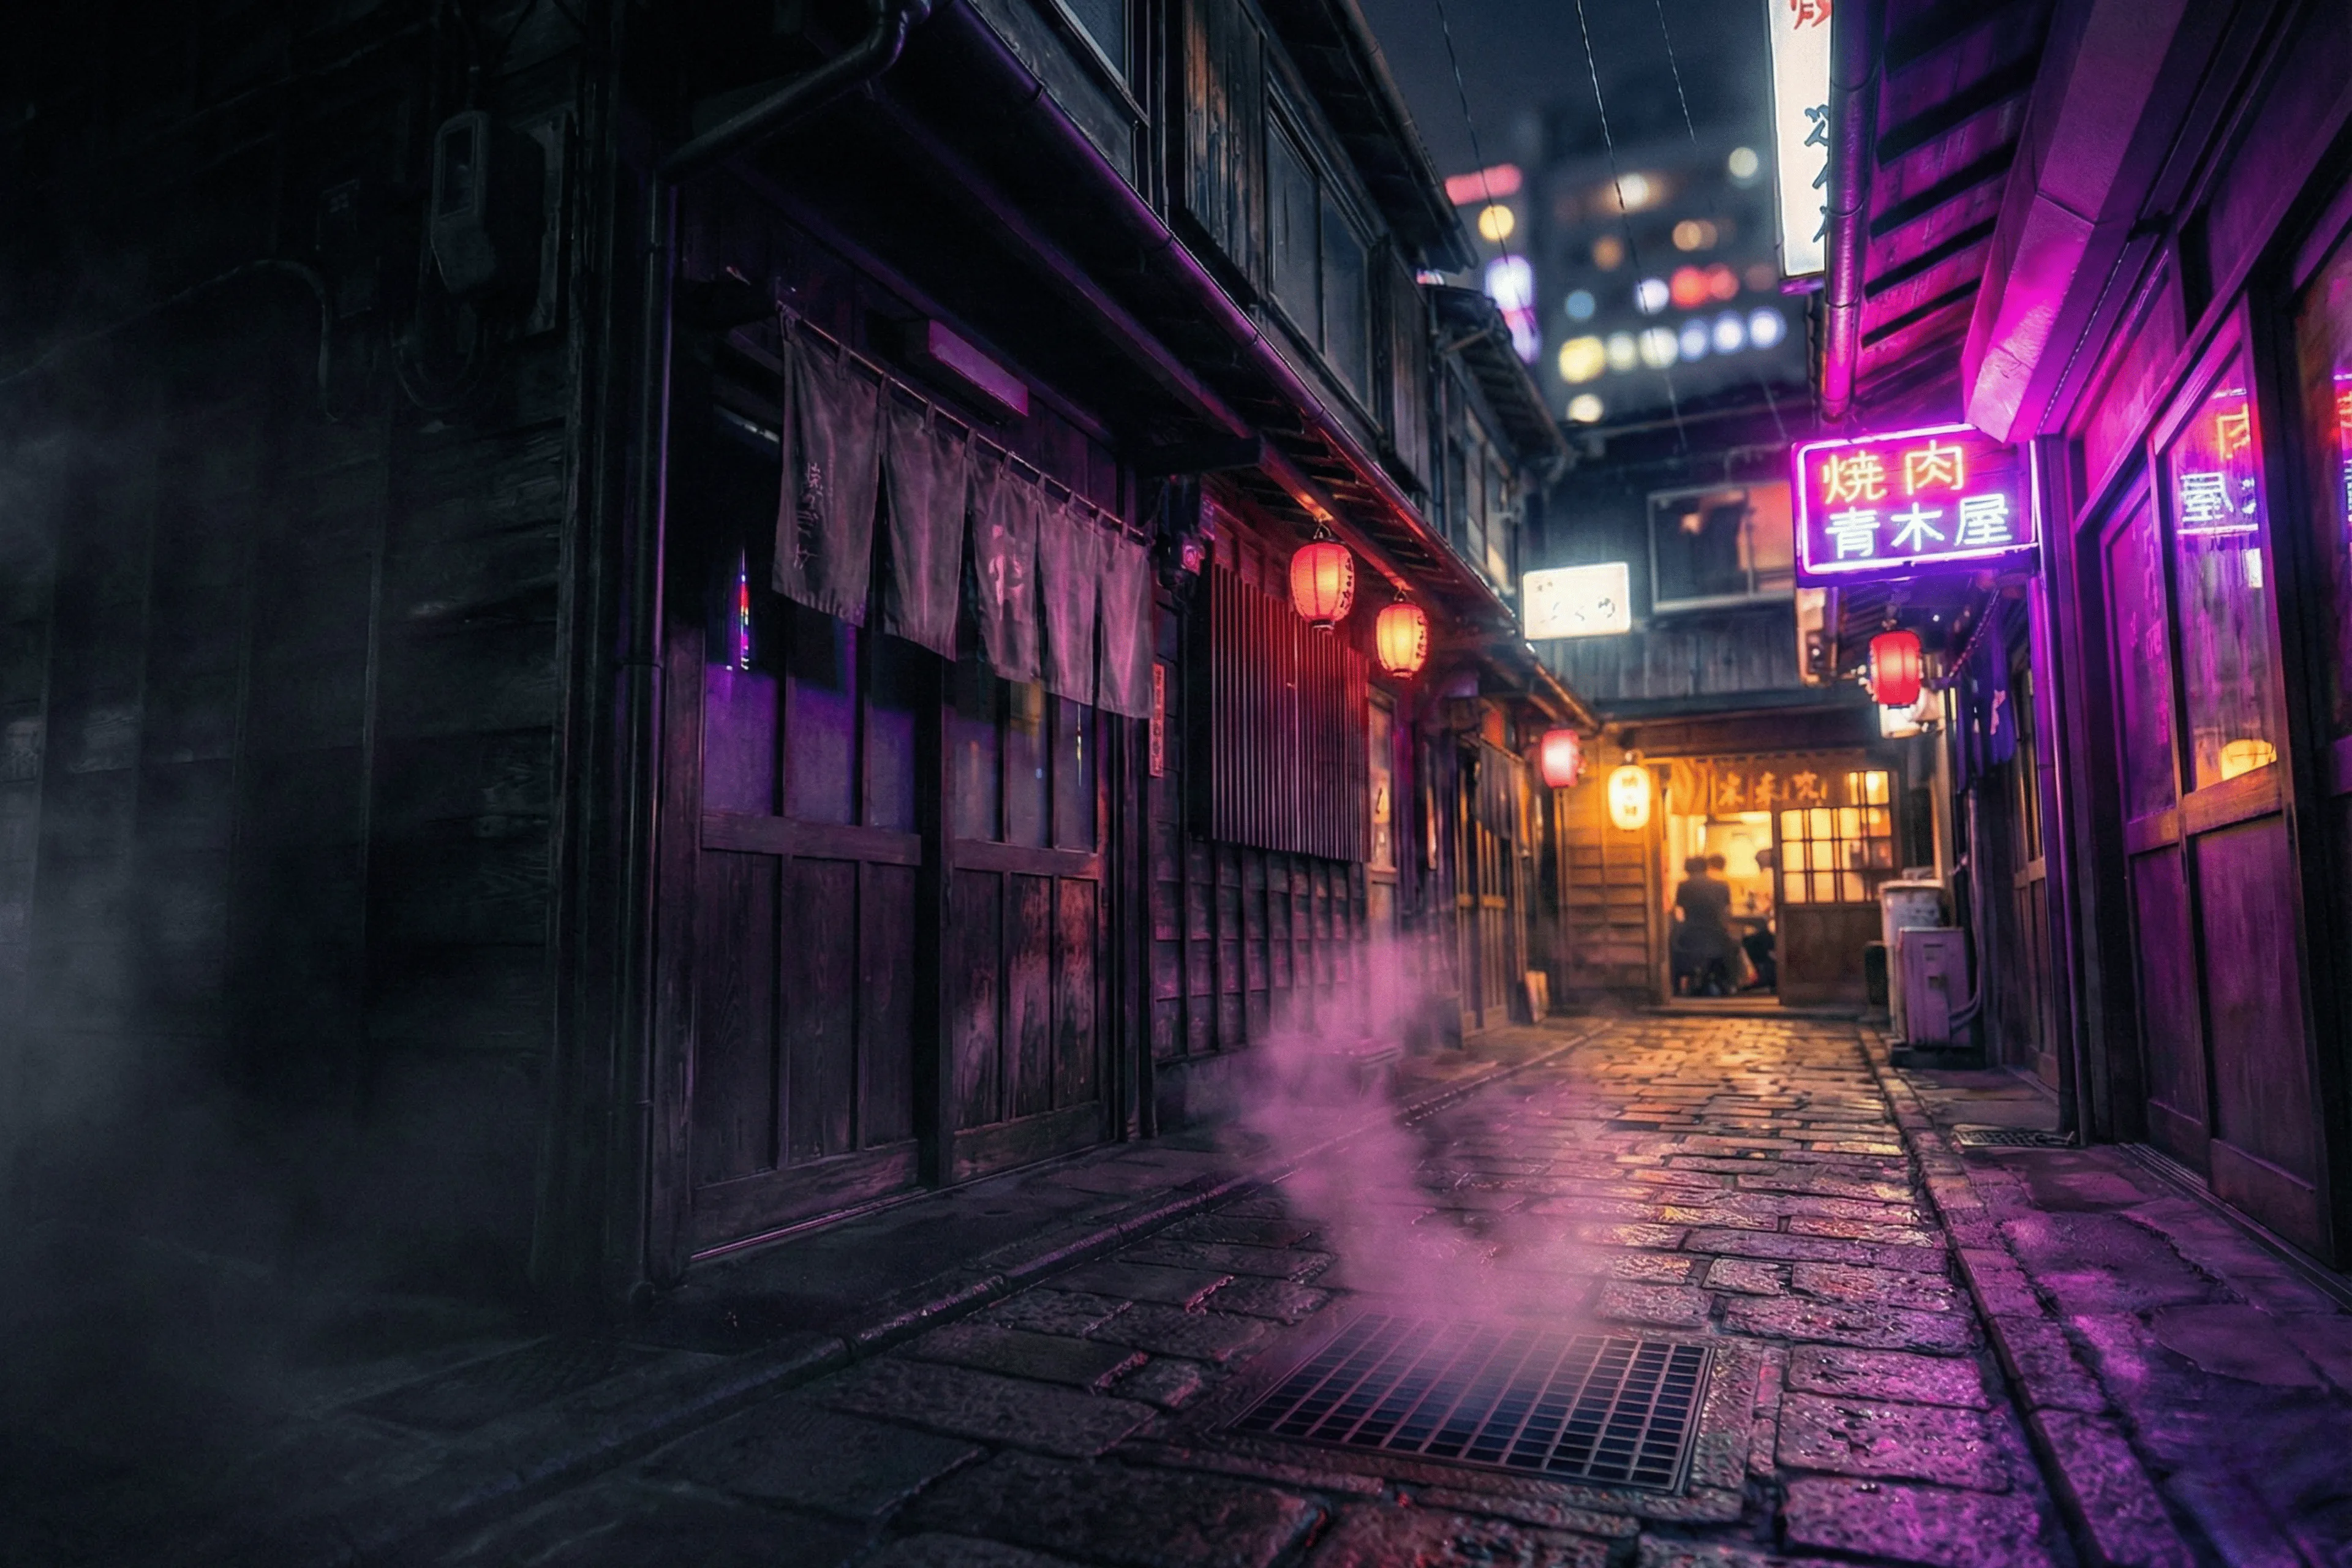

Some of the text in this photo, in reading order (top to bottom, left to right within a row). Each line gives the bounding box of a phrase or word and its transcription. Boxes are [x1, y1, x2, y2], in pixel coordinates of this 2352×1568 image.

[1822, 439, 1964, 504] 焼肉
[1825, 493, 2012, 559] 青木屋
